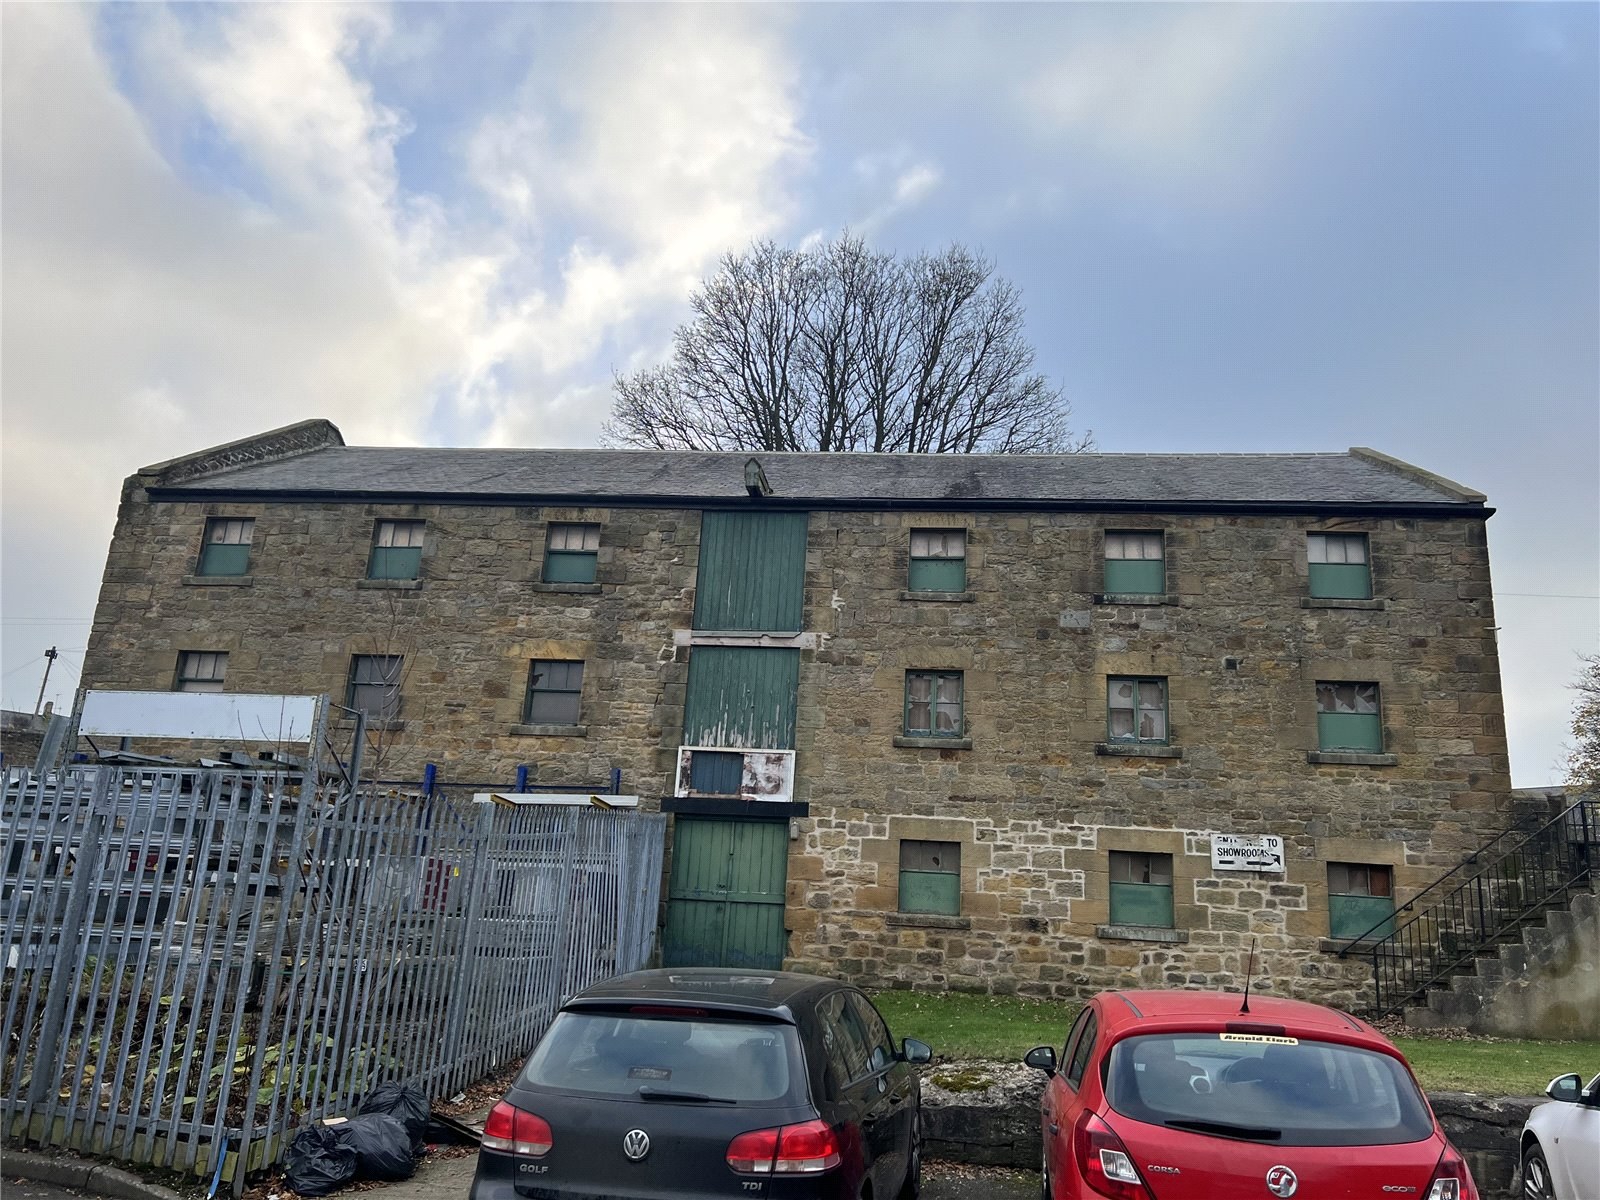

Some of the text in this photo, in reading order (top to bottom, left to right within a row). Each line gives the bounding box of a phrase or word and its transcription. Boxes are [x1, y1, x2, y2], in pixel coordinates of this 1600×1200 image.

[1266, 838, 1277, 847] TO
[519, 1163, 549, 1174] GOLF
[1147, 1164, 1181, 1174] CORSA
[742, 1181, 763, 1190] TDI
